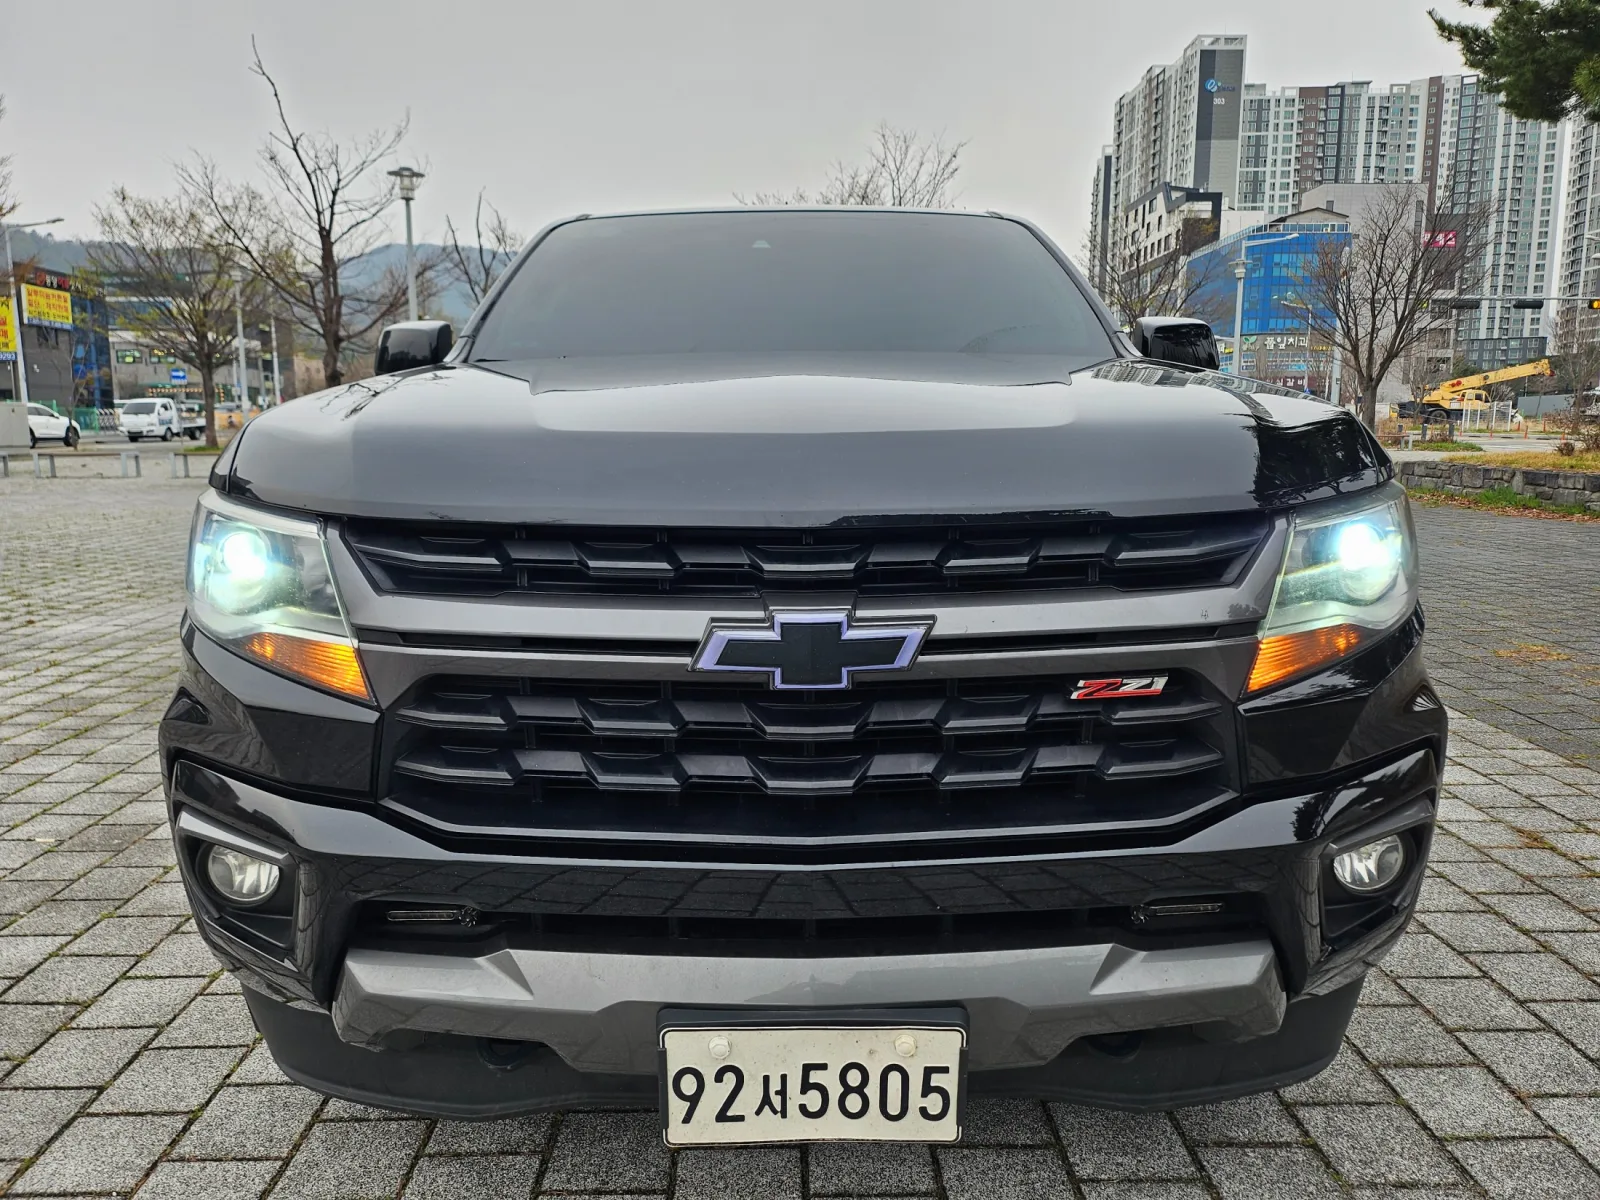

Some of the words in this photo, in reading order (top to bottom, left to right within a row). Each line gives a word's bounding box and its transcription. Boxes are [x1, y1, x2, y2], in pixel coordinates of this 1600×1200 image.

[1264, 336, 1309, 350] 풀잎치과
[1070, 676, 1169, 700] Z71
[671, 1061, 951, 1124] 92서5805
